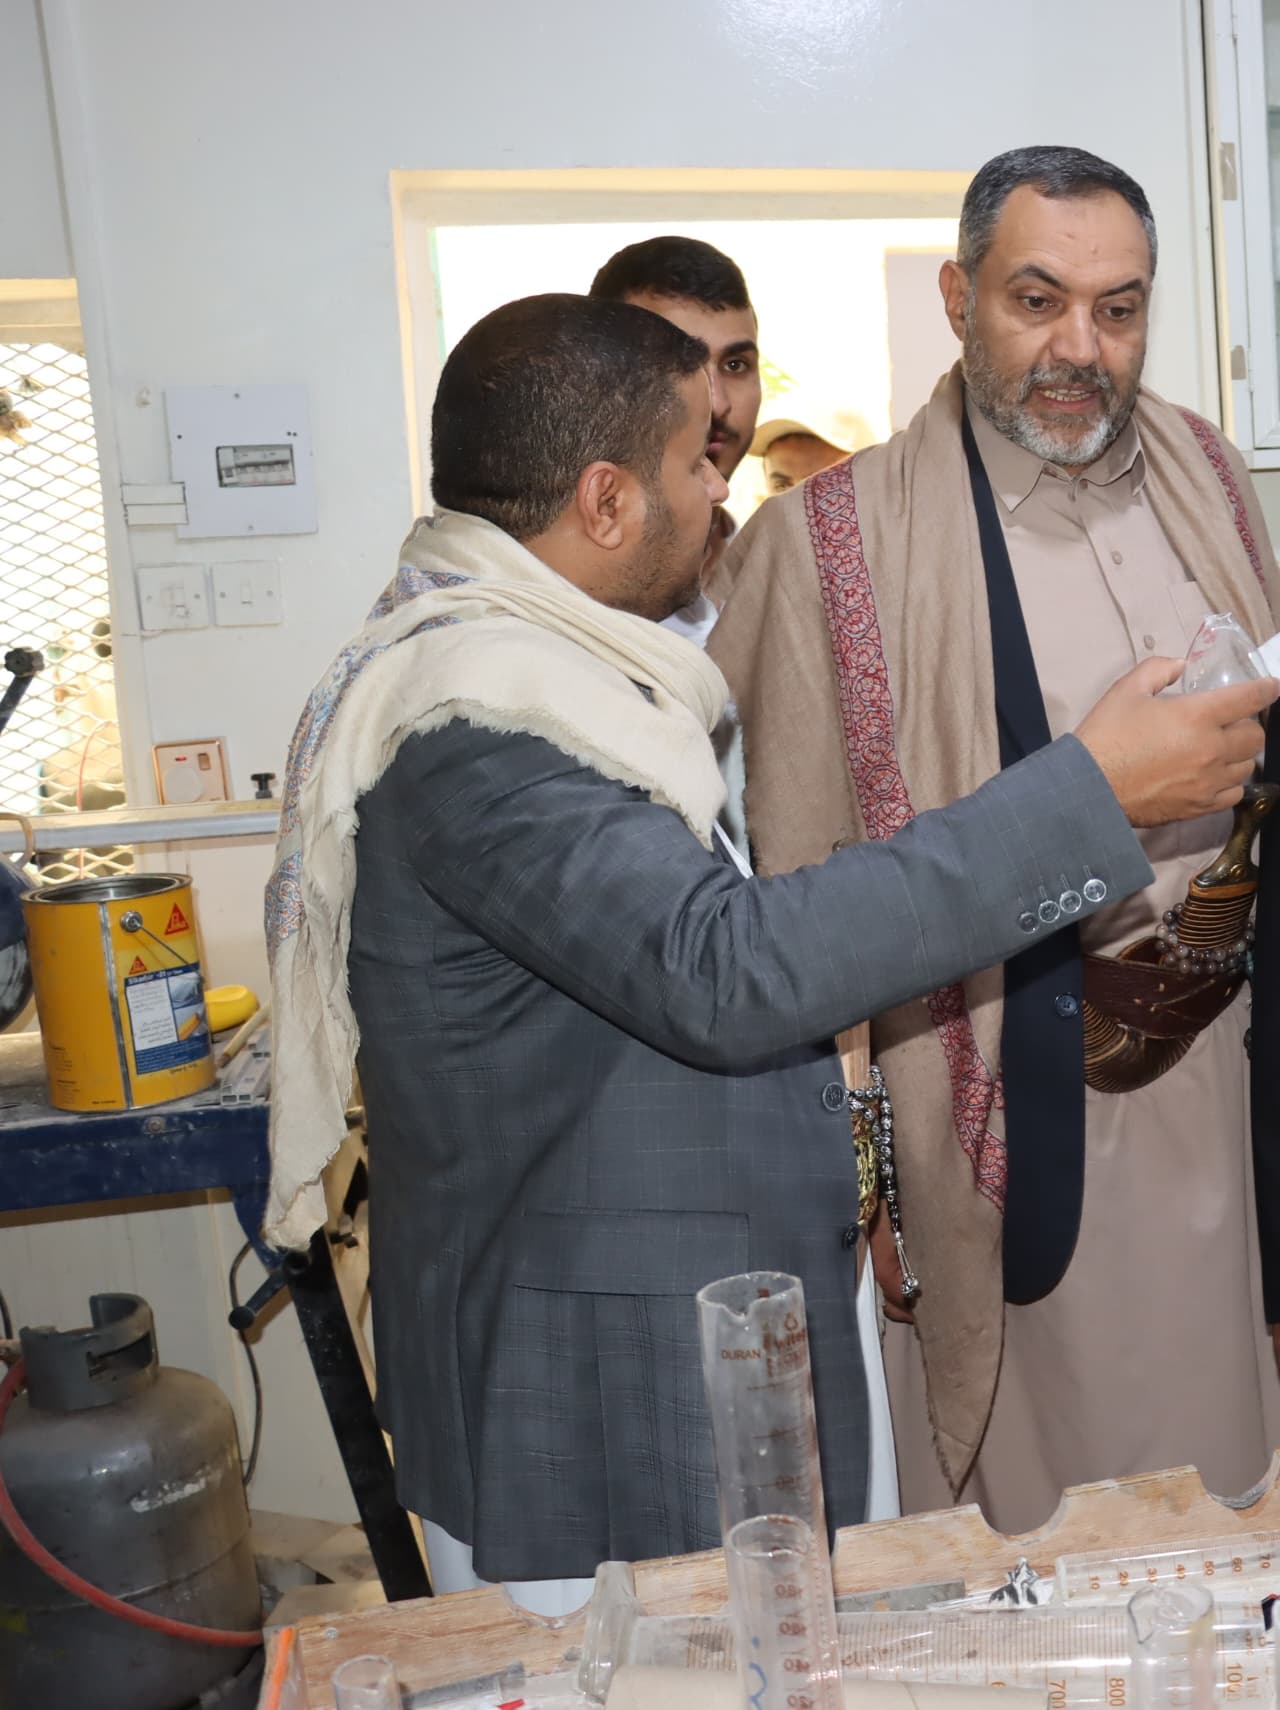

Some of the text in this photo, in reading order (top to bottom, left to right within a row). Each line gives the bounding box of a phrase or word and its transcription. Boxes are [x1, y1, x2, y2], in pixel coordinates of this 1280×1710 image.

[721, 1349, 761, 1360] DURAN
[1261, 1553, 1271, 1569] 70
[1089, 1576, 1100, 1590] 10
[1119, 1571, 1129, 1587] 20
[1147, 1568, 1157, 1583] 30
[1050, 1680, 1066, 1709] 700
[1109, 1677, 1125, 1707] 800
